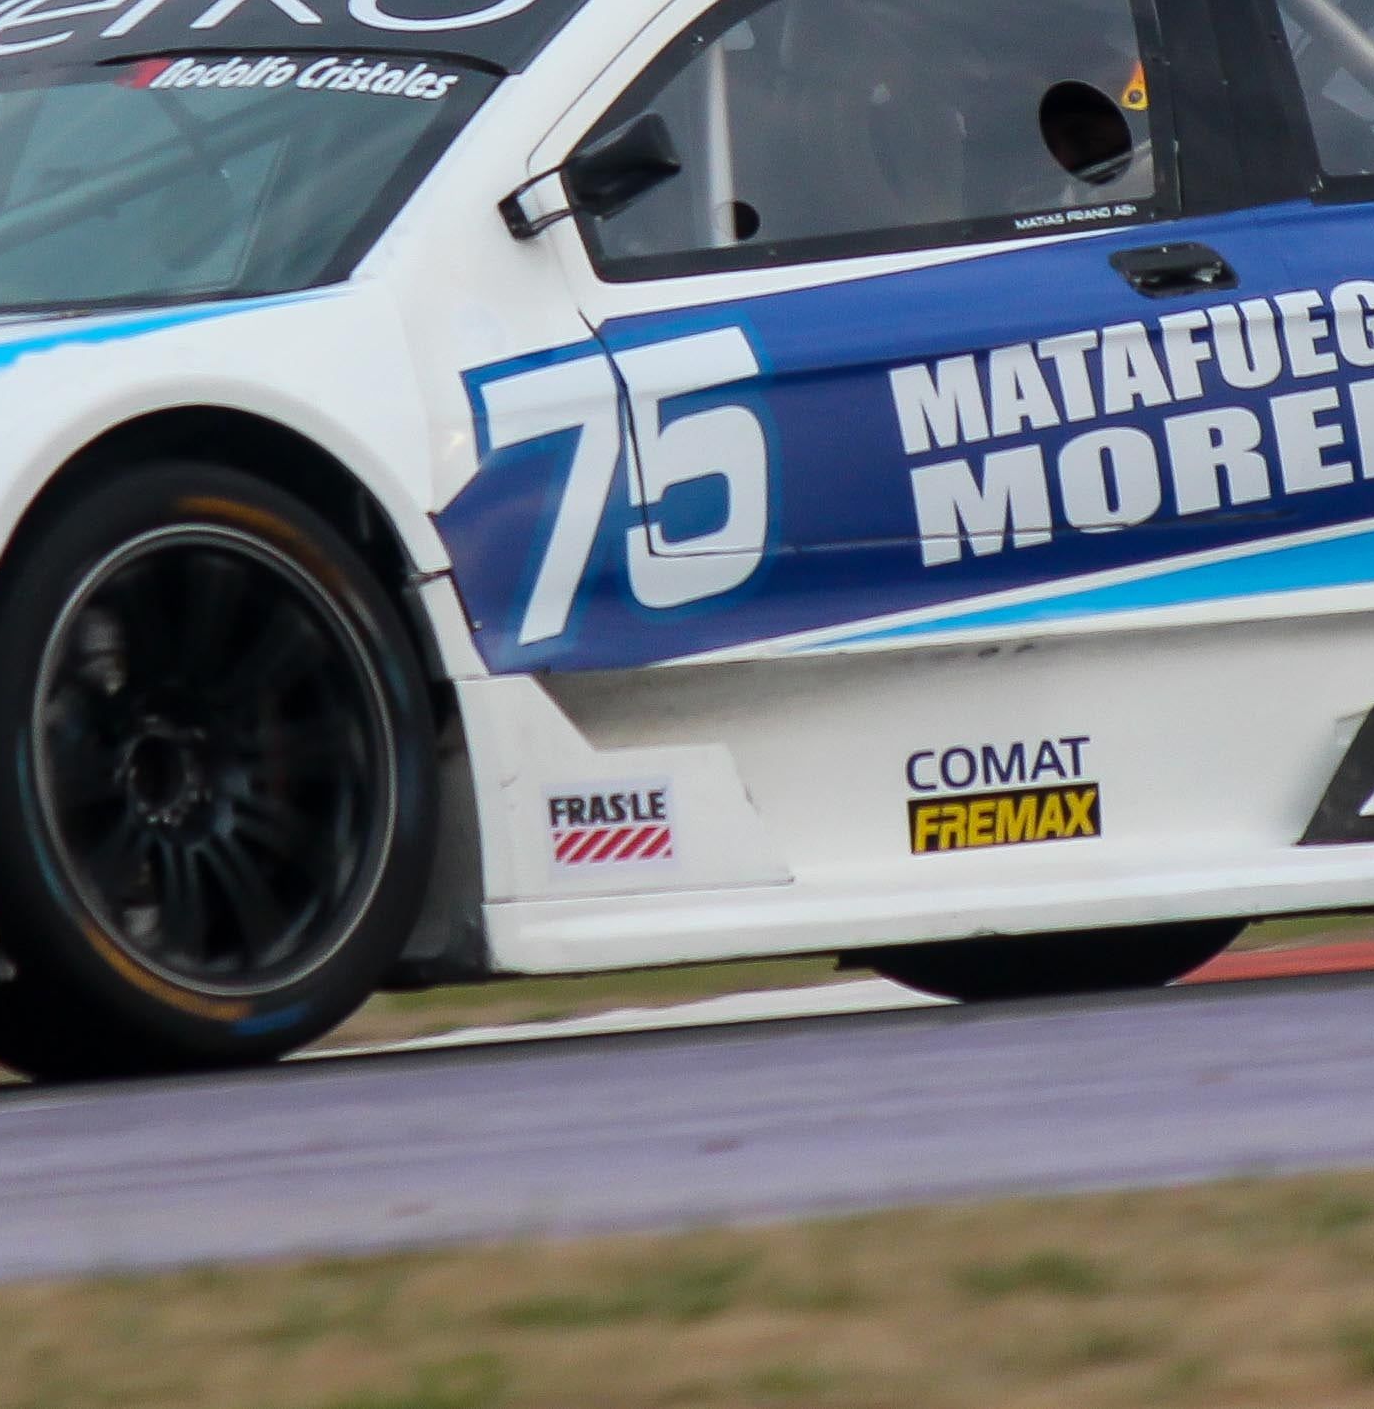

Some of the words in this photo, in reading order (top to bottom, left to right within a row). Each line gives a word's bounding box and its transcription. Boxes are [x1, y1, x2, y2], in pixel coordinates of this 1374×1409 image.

[296, 57, 459, 99] Cristales
[480, 326, 768, 645] 75
[907, 737, 1090, 792] COMAT
[914, 789, 1096, 853] FREMAX
